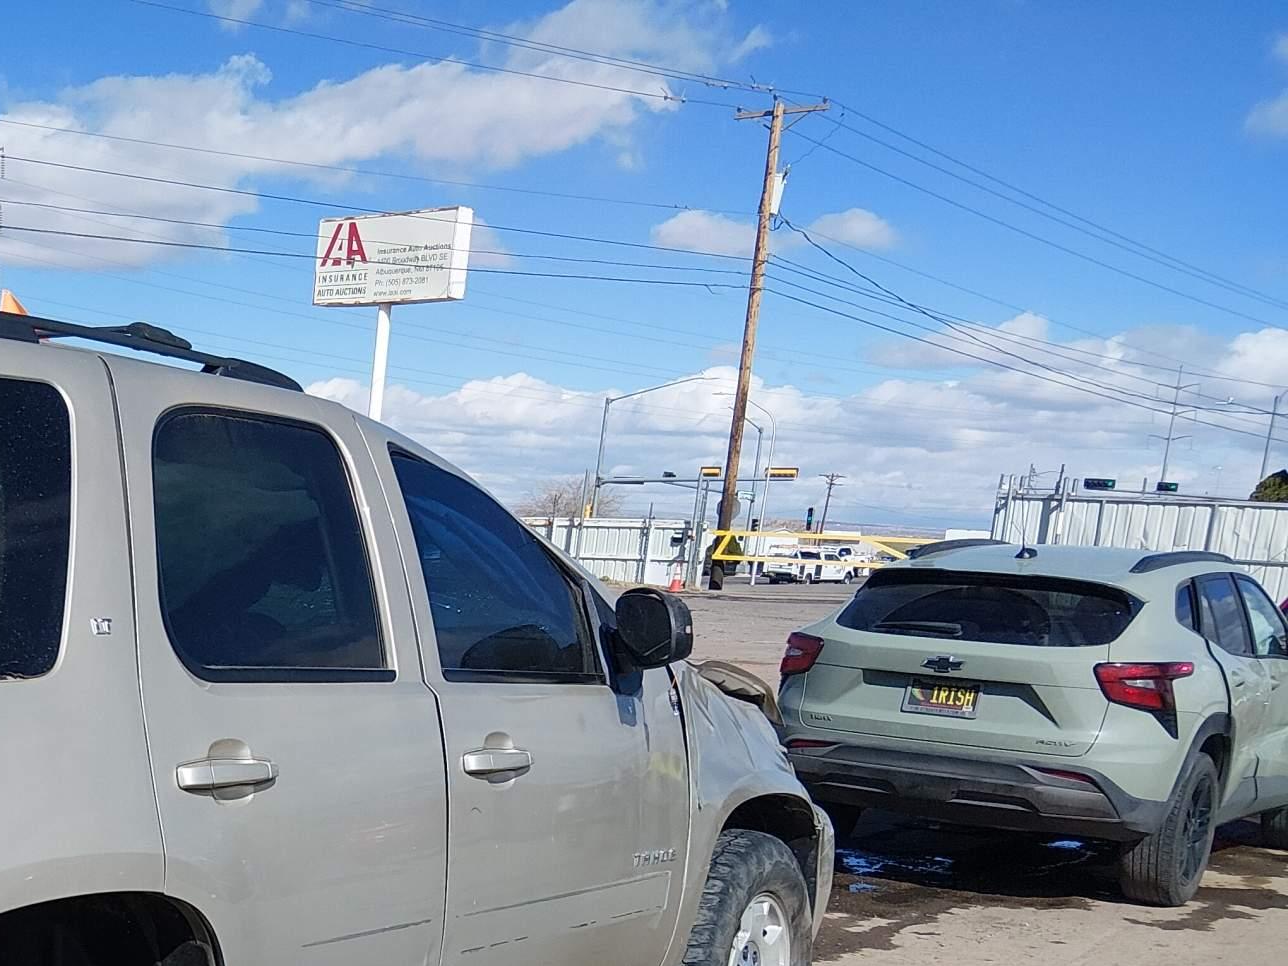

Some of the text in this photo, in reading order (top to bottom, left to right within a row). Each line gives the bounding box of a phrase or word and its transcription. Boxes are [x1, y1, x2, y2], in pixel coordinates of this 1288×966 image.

[377, 246, 407, 255] Insurance
[424, 243, 451, 251] Auctions
[421, 253, 437, 262] BLVD
[439, 252, 449, 261] SE
[318, 272, 368, 284] INSURANCE
[385, 278, 401, 288] (505)
[317, 286, 367, 297] AUTO AUCTIONS
[929, 686, 975, 708] IRISH
